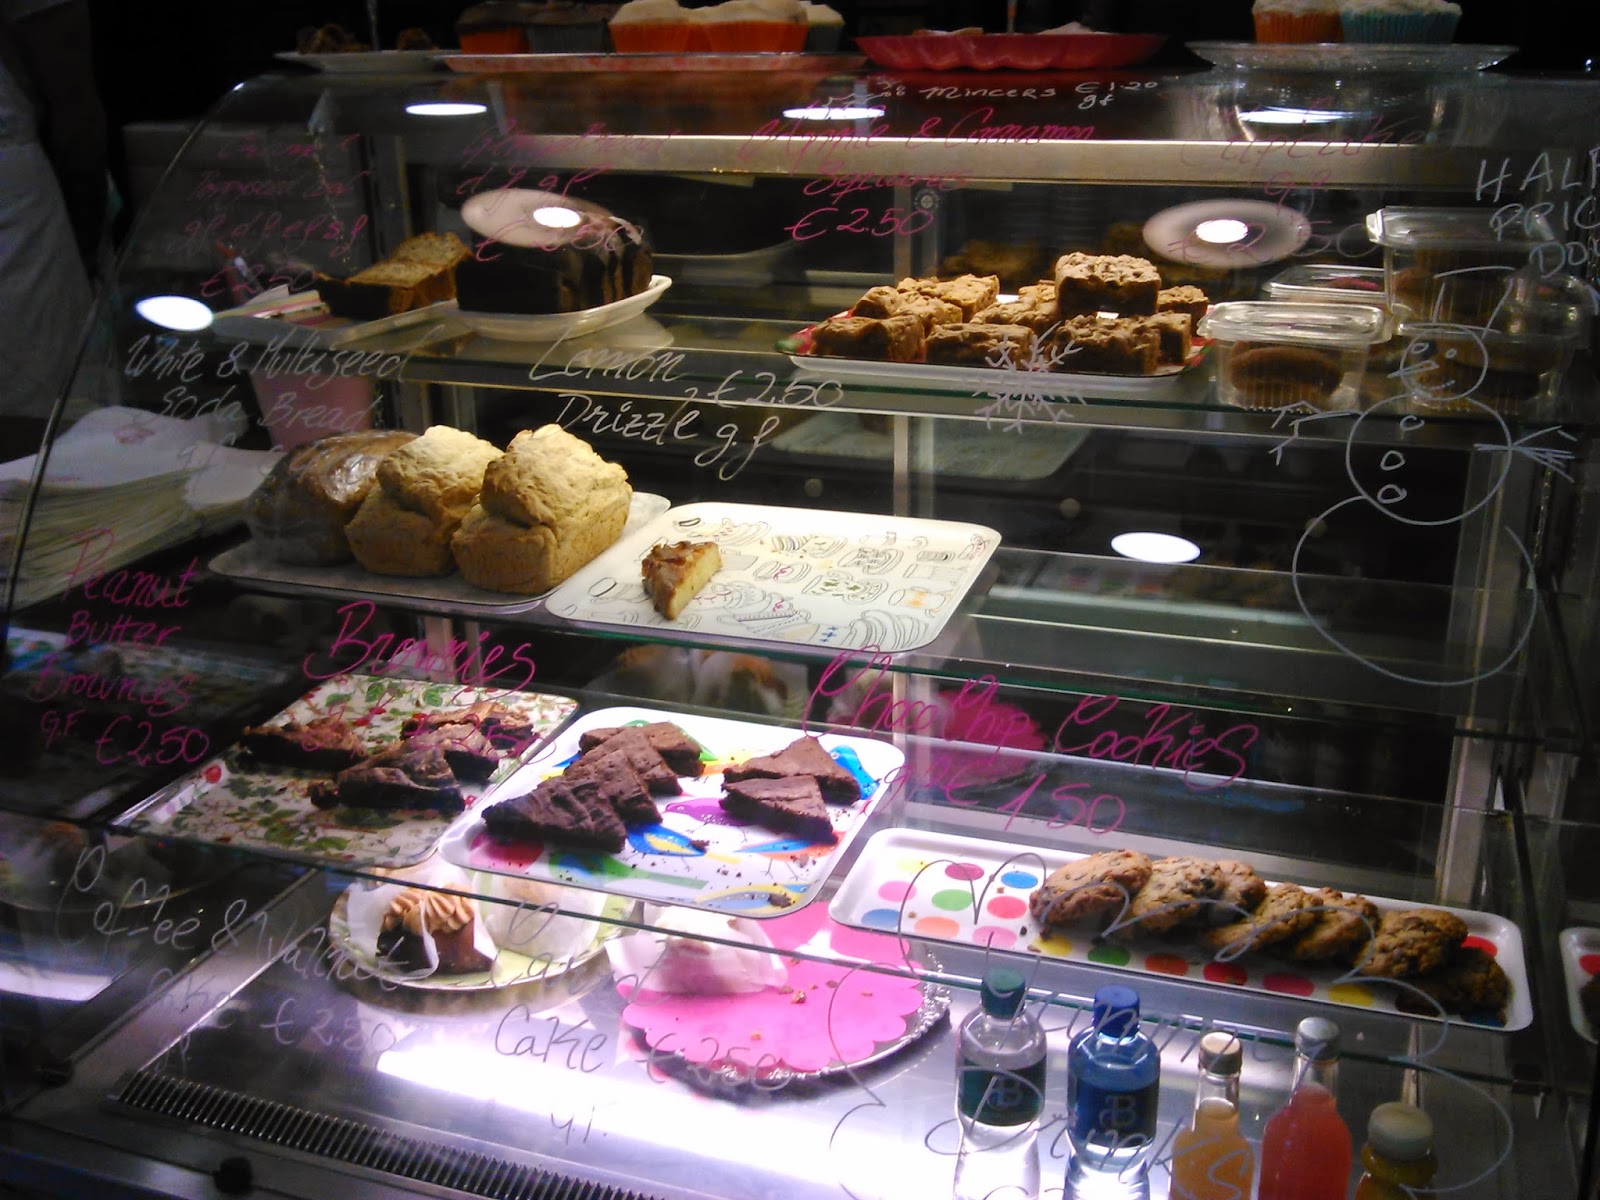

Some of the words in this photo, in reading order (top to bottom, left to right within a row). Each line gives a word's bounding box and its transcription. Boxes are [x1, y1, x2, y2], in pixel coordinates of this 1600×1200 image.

[944, 106, 1096, 148] Cinnamon
[802, 159, 973, 205] Squares
[783, 206, 936, 242] €2.50
[124, 334, 205, 382] White
[216, 340, 249, 379] &
[250, 323, 446, 388] Multiseed
[528, 326, 692, 384] Lemon
[707, 368, 846, 410] €2.50
[158, 385, 246, 422] Soda
[258, 392, 384, 434] Bread
[555, 386, 701, 447] Drizzle
[60, 527, 200, 609] Peanut
[65, 608, 184, 652] Butter
[302, 598, 539, 708] Brownies
[26, 652, 198, 718] Brownies
[94, 713, 211, 767] €2.50
[1053, 693, 1260, 792] Cookies
[55, 843, 202, 958] Coffee
[211, 898, 249, 952] &
[494, 1003, 609, 1074] Cake
